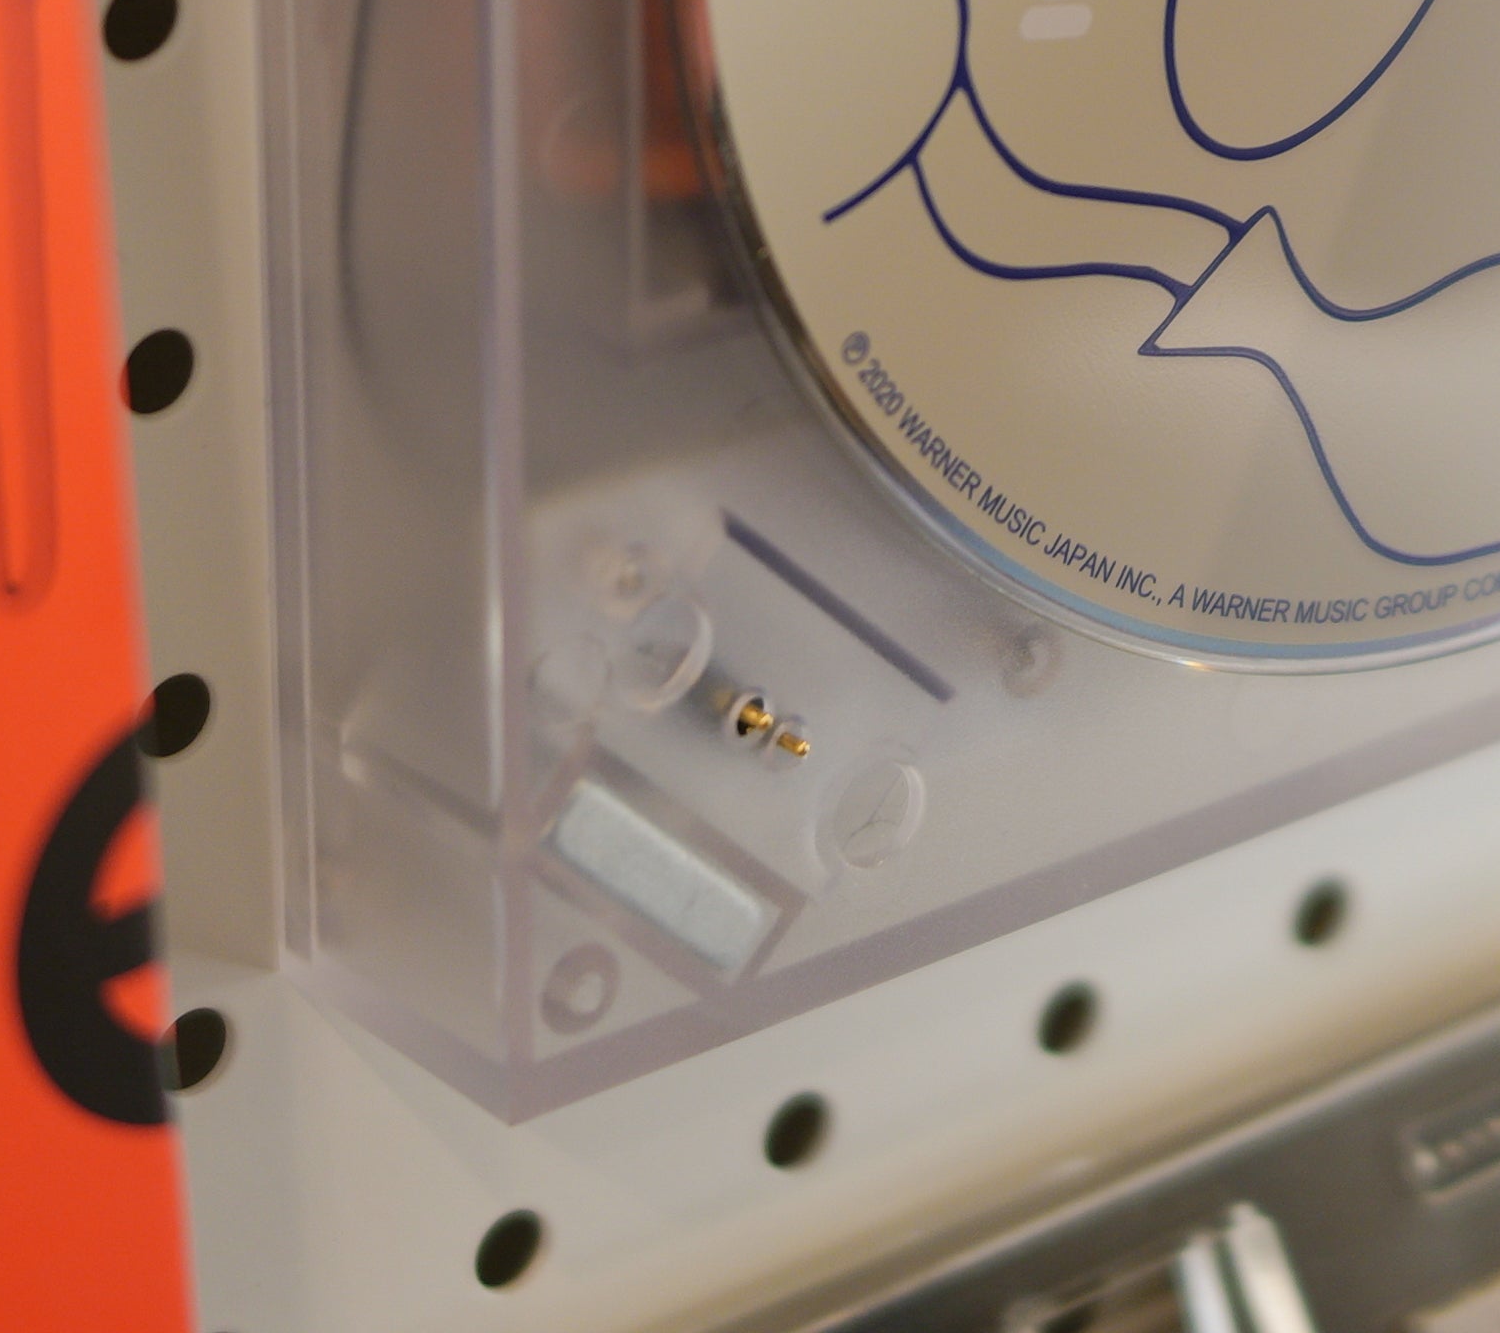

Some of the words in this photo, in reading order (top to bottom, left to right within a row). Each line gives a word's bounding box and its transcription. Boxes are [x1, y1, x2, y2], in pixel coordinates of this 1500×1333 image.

[857, 358, 905, 417] 2020
[898, 406, 982, 501] WARNER
[977, 486, 1046, 546] MUSIC
[1044, 533, 1117, 583] JAPAN
[1116, 564, 1162, 607] INC.,
[1167, 583, 1186, 608] A
[1192, 586, 1291, 623] WARNER
[1294, 598, 1370, 624] MUSIC
[1374, 584, 1458, 620] GROUP
